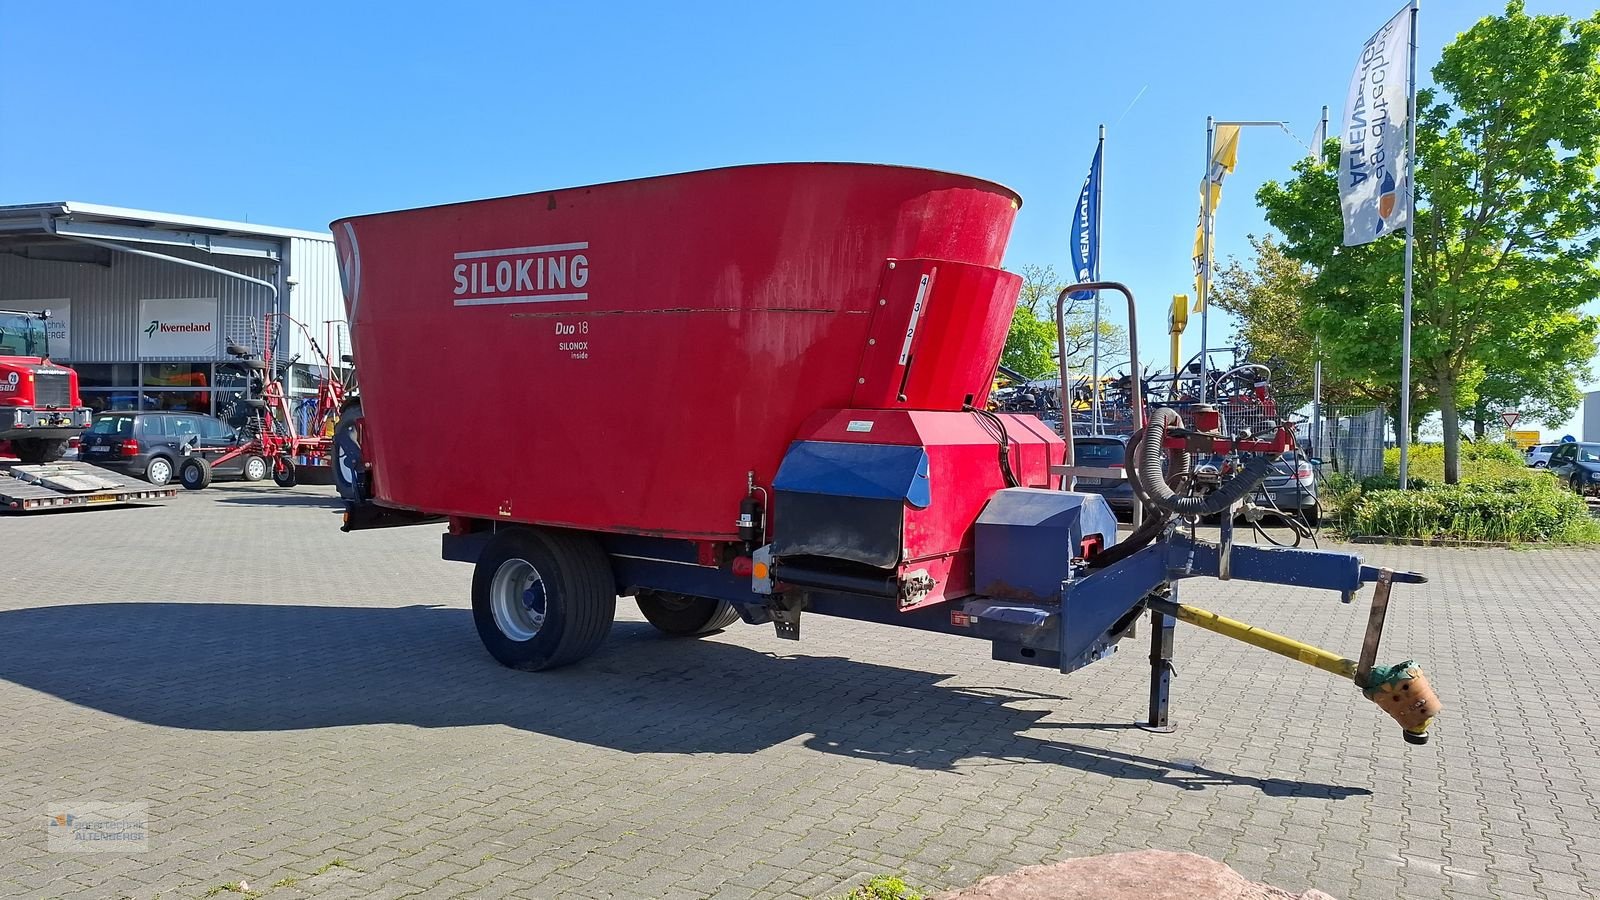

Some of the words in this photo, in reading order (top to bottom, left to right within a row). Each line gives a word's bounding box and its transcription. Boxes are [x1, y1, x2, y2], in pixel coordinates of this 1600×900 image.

[453, 254, 589, 295] SILOKING
[920, 278, 927, 286] 4
[914, 303, 920, 312] 3
[160, 322, 211, 332] Kverneland
[555, 322, 575, 335] Duo
[578, 321, 589, 334] 18
[907, 329, 913, 337] 2
[559, 342, 588, 351] SILONOX
[571, 351, 589, 359] inside
[901, 353, 906, 362] 1
